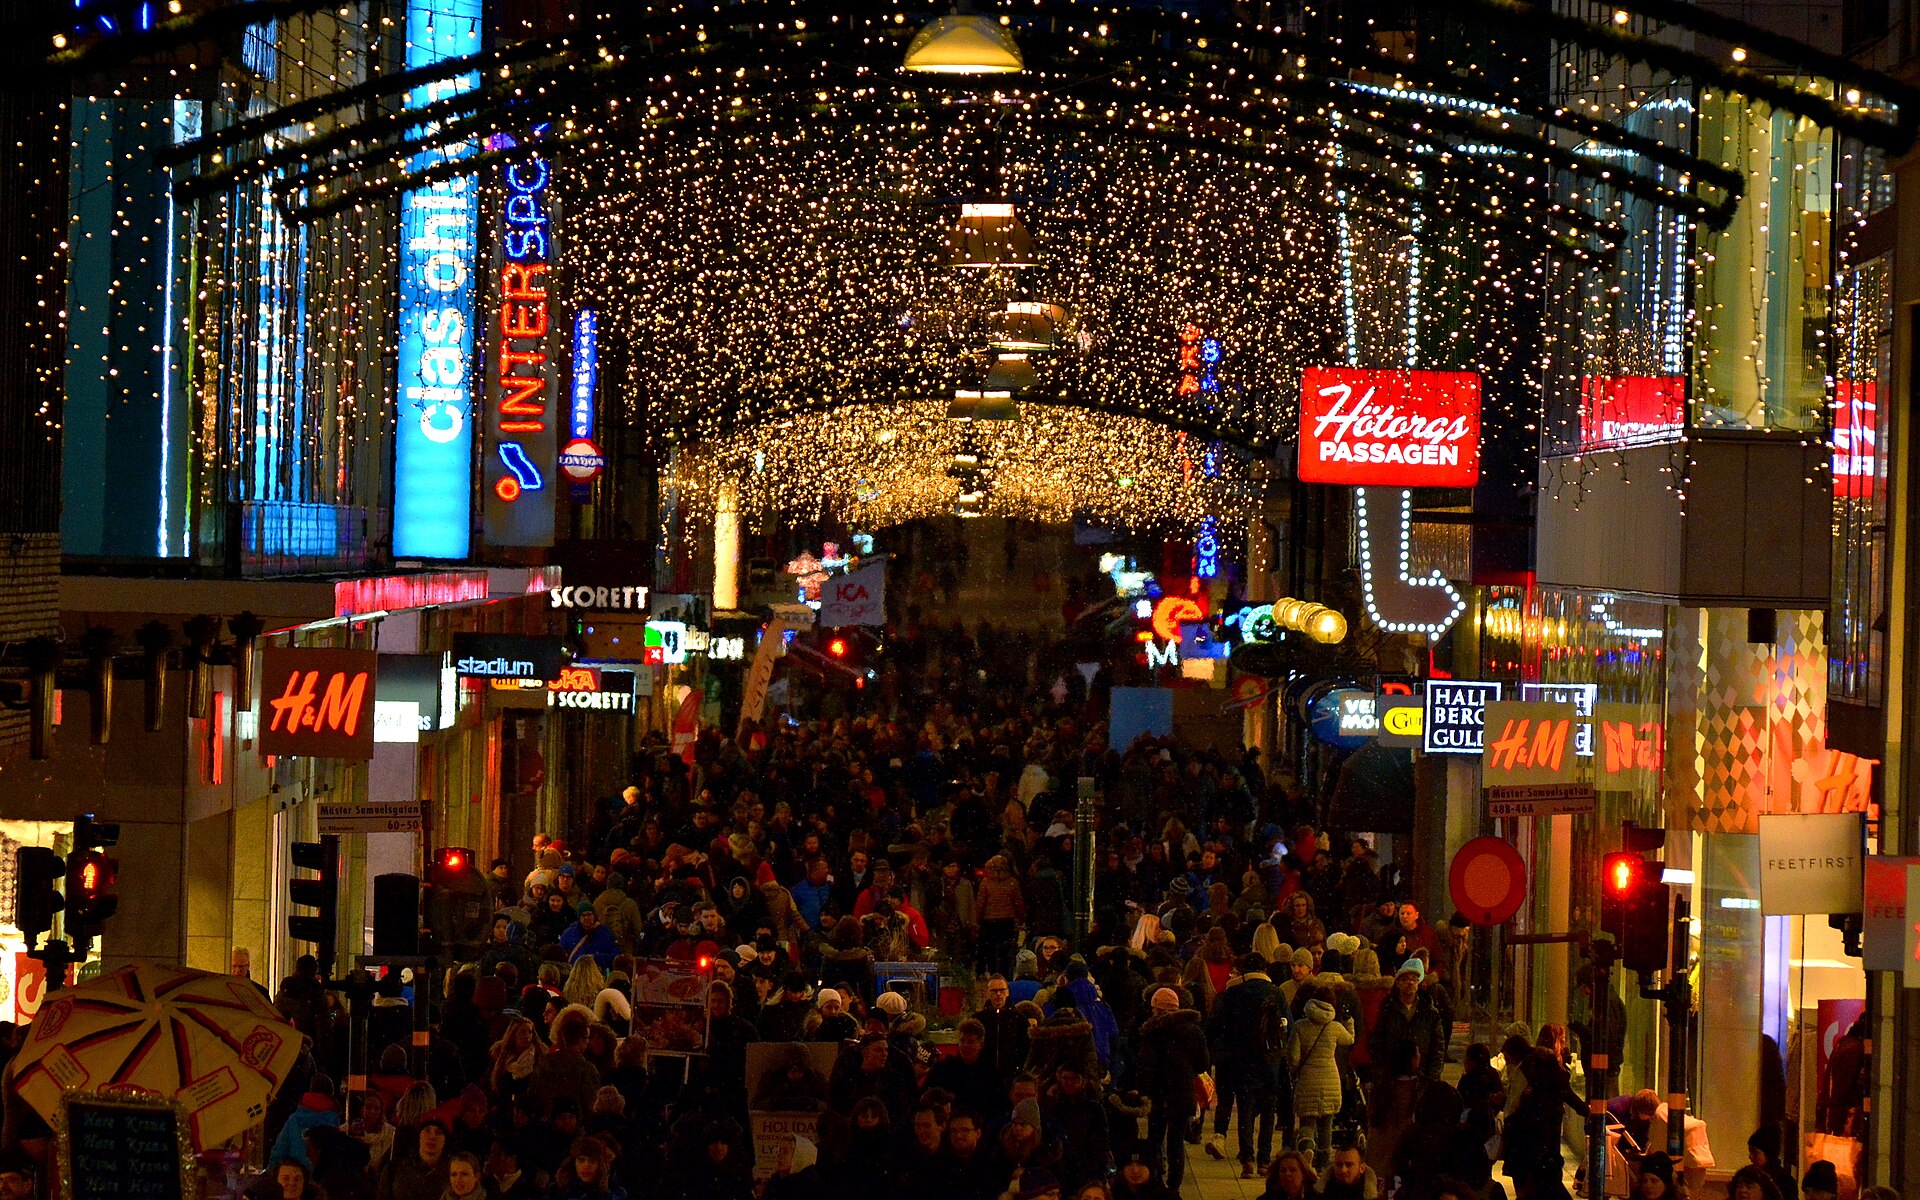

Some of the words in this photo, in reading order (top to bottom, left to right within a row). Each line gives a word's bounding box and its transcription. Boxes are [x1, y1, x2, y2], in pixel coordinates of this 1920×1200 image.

[406, 307, 465, 443] clas
[1314, 384, 1469, 444] Hötorgs
[558, 455, 604, 467] LONDON
[1320, 441, 1458, 466] PASSAGEN
[550, 586, 648, 609] SCORETT
[836, 584, 868, 602] ICA
[457, 656, 534, 676] stadium
[270, 670, 368, 736] H&M
[558, 692, 631, 709] SCORETT
[1490, 718, 1570, 772] H&M
[1528, 786, 1588, 798] Samuelsgatan
[320, 804, 352, 815] Mäster
[356, 804, 418, 816] Samuelsgatan
[388, 820, 419, 830] 60-50
[1768, 856, 1854, 870] FEETFIRST
[762, 1120, 818, 1132] HOLIDA
